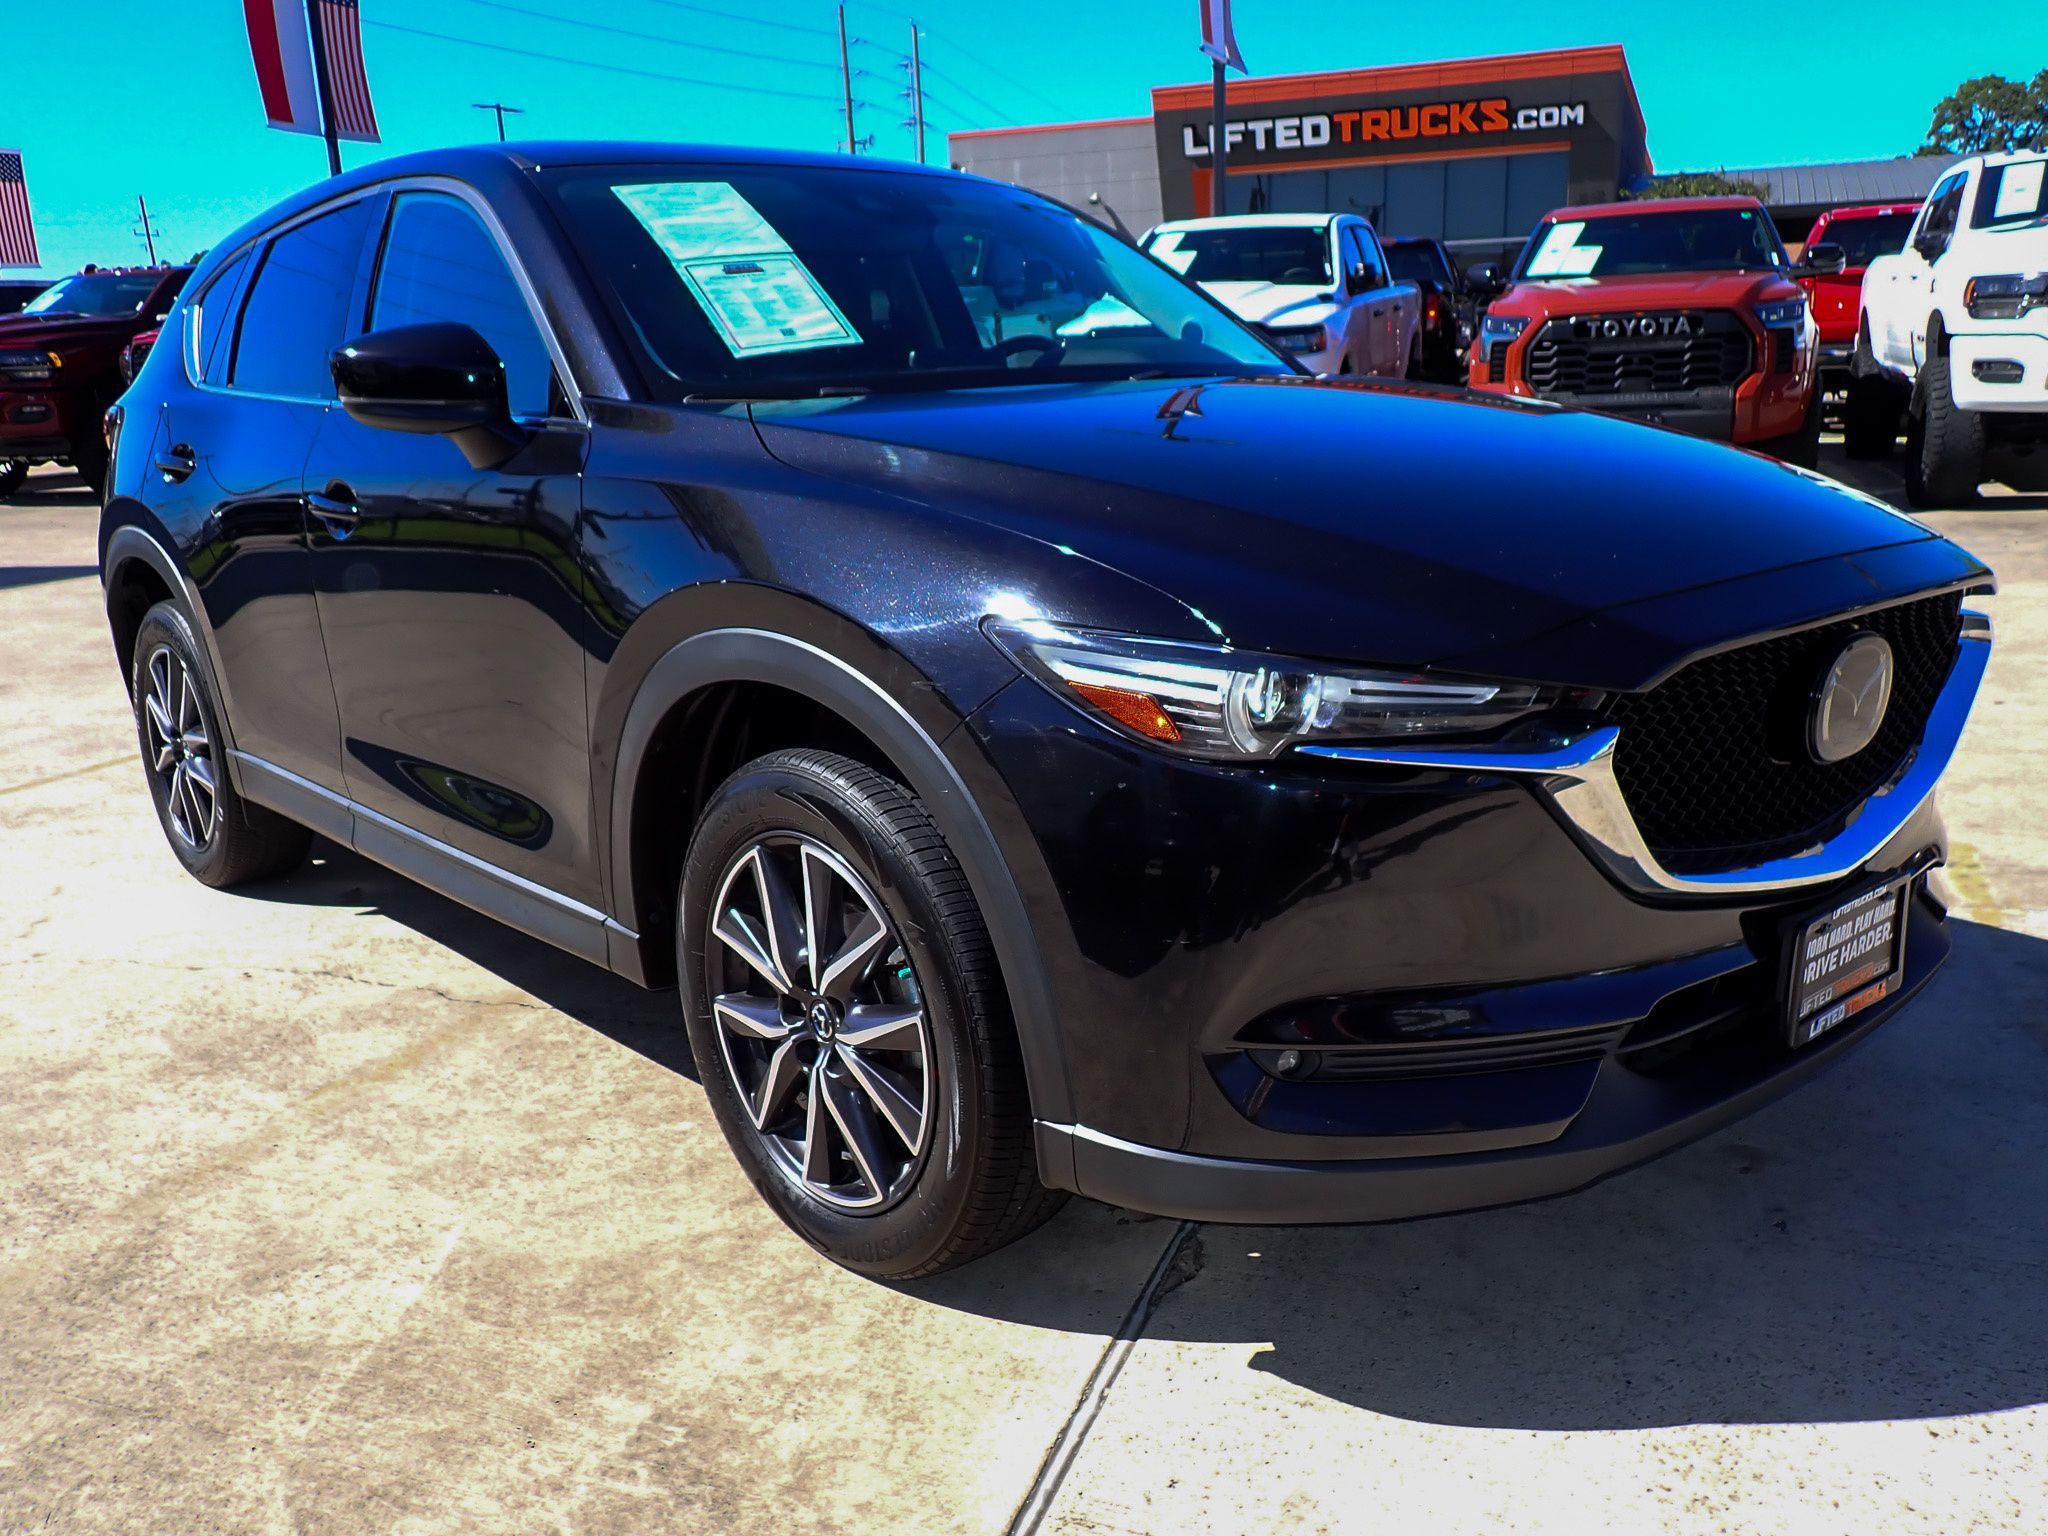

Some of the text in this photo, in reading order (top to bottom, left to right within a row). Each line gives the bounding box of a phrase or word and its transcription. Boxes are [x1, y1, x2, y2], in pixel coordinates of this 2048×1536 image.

[1586, 316, 1691, 338] TOYOTA
[1806, 932, 1829, 960] ORK
[1854, 908, 1874, 936] PLAY
[1839, 921, 1893, 966] HARDER.
